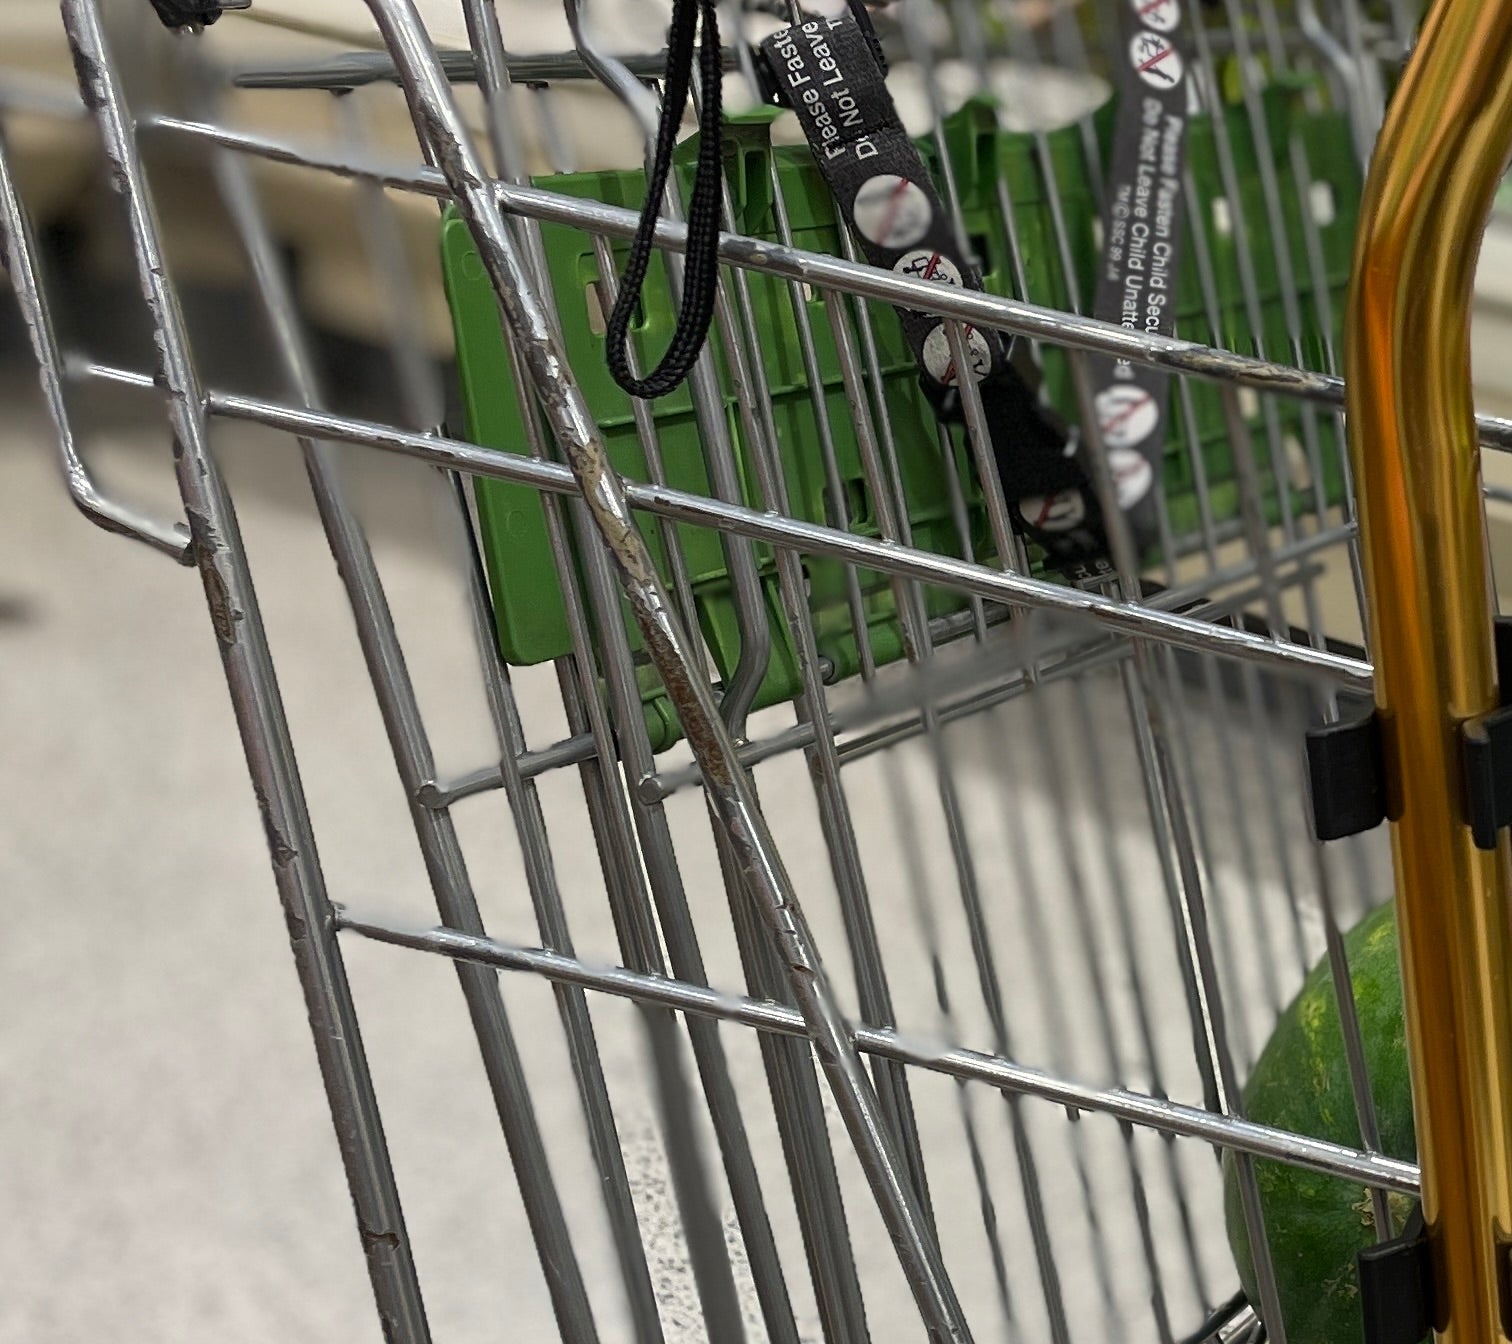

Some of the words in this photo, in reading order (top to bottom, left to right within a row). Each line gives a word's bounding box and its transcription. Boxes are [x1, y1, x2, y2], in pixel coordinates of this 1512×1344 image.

[774, 23, 810, 87] Faste
[802, 22, 843, 86] Leave
[831, 88, 863, 127] Not
[1142, 97, 1162, 126] Do
[1140, 127, 1160, 161] Not
[1161, 115, 1183, 176] Please
[1134, 162, 1156, 217] Leave
[1156, 177, 1179, 237] Fasten
[1127, 221, 1149, 271] Child
[1149, 241, 1172, 288] Child
[1114, 276, 1142, 380] Unatteed
[1146, 293, 1166, 334] Secu
